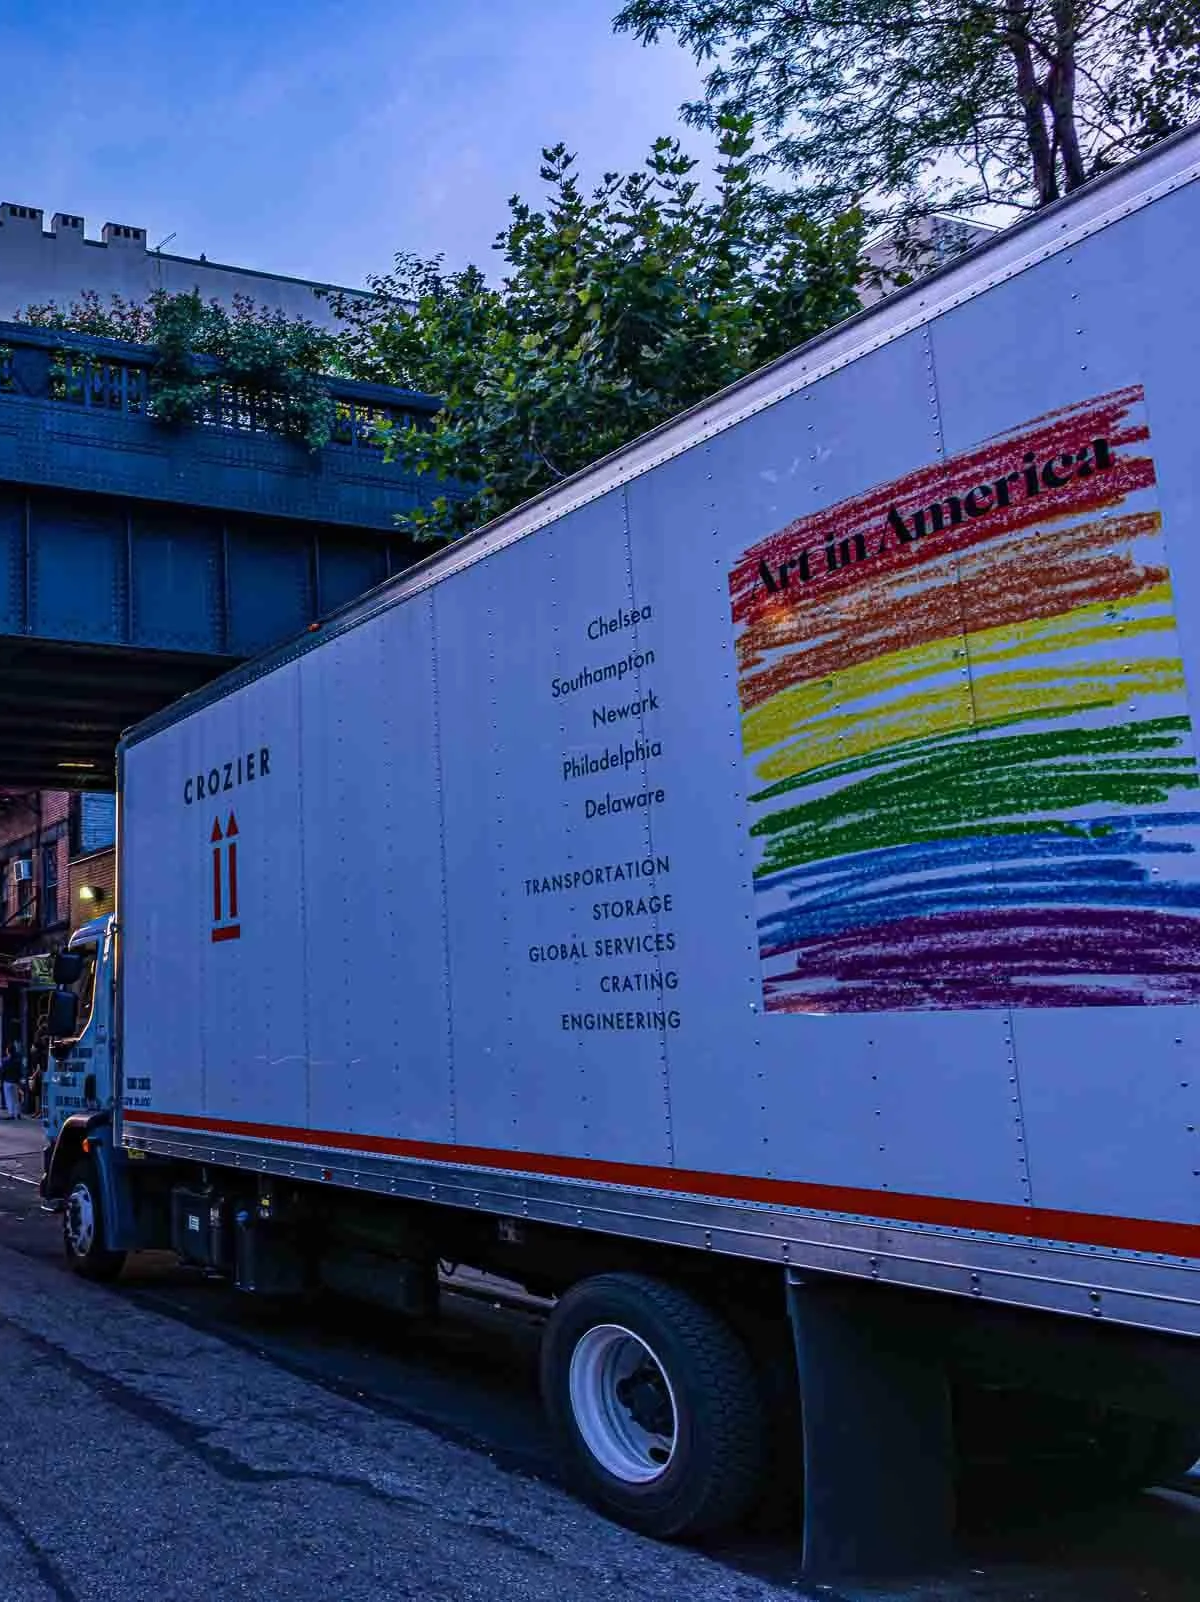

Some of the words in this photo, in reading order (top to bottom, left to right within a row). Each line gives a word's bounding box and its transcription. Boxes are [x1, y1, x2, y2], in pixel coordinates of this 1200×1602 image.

[756, 549, 814, 592] Art
[825, 532, 869, 572] in
[877, 438, 1113, 551] America
[587, 605, 653, 640] Chelsea
[552, 650, 656, 698] Southampton
[592, 690, 660, 728] Newark
[184, 747, 271, 805] CROZIER
[563, 739, 662, 781] Philadelphia
[585, 788, 665, 819] Delaware
[525, 856, 670, 896] TRANSPORTATION
[593, 894, 673, 920] STORAGE
[529, 944, 588, 962] GLOBAL
[595, 933, 676, 957] SERVICES
[600, 971, 678, 993] CRATING
[562, 1010, 681, 1031] ENGINEERING
